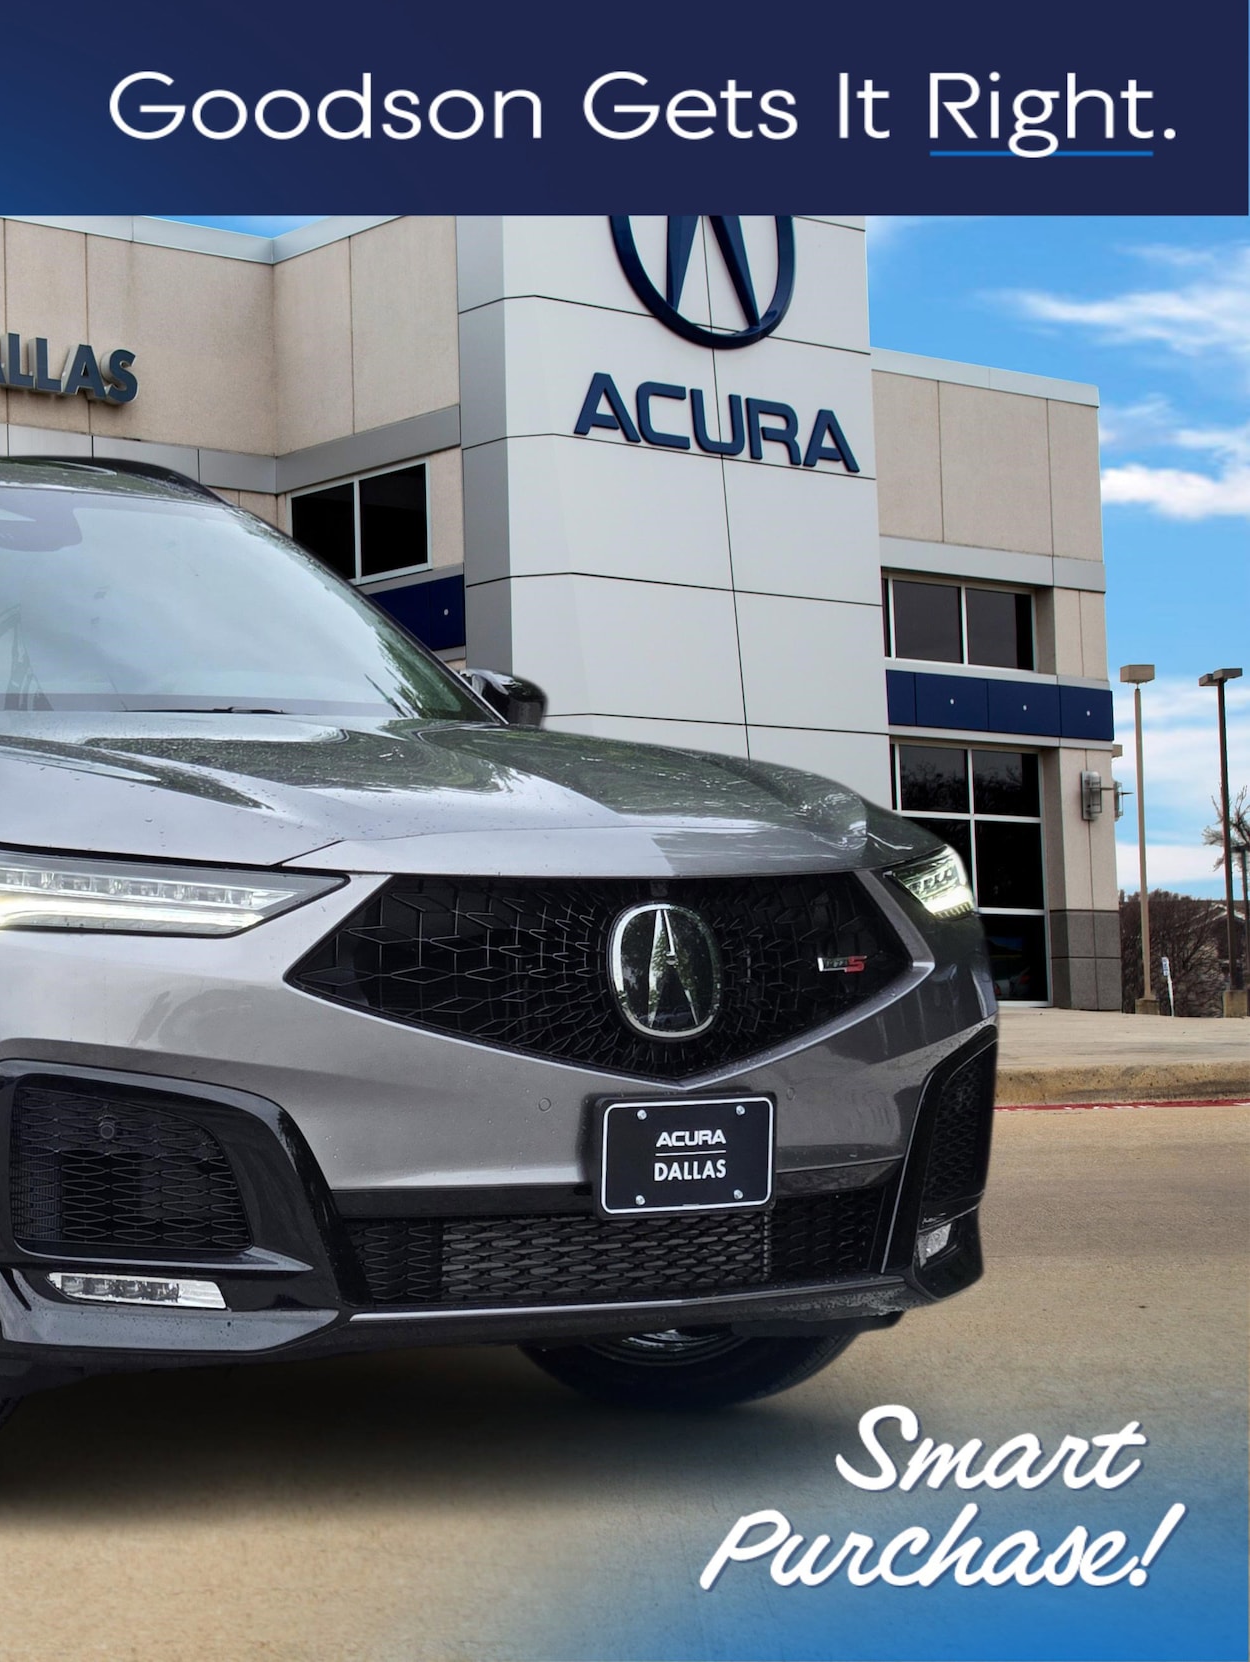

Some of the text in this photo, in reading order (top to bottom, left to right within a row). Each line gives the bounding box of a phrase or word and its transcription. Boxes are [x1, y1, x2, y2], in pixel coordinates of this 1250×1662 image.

[573, 372, 860, 473] ACURA
[655, 1128, 727, 1148] ACURA
[654, 1159, 727, 1182] DALLAS
